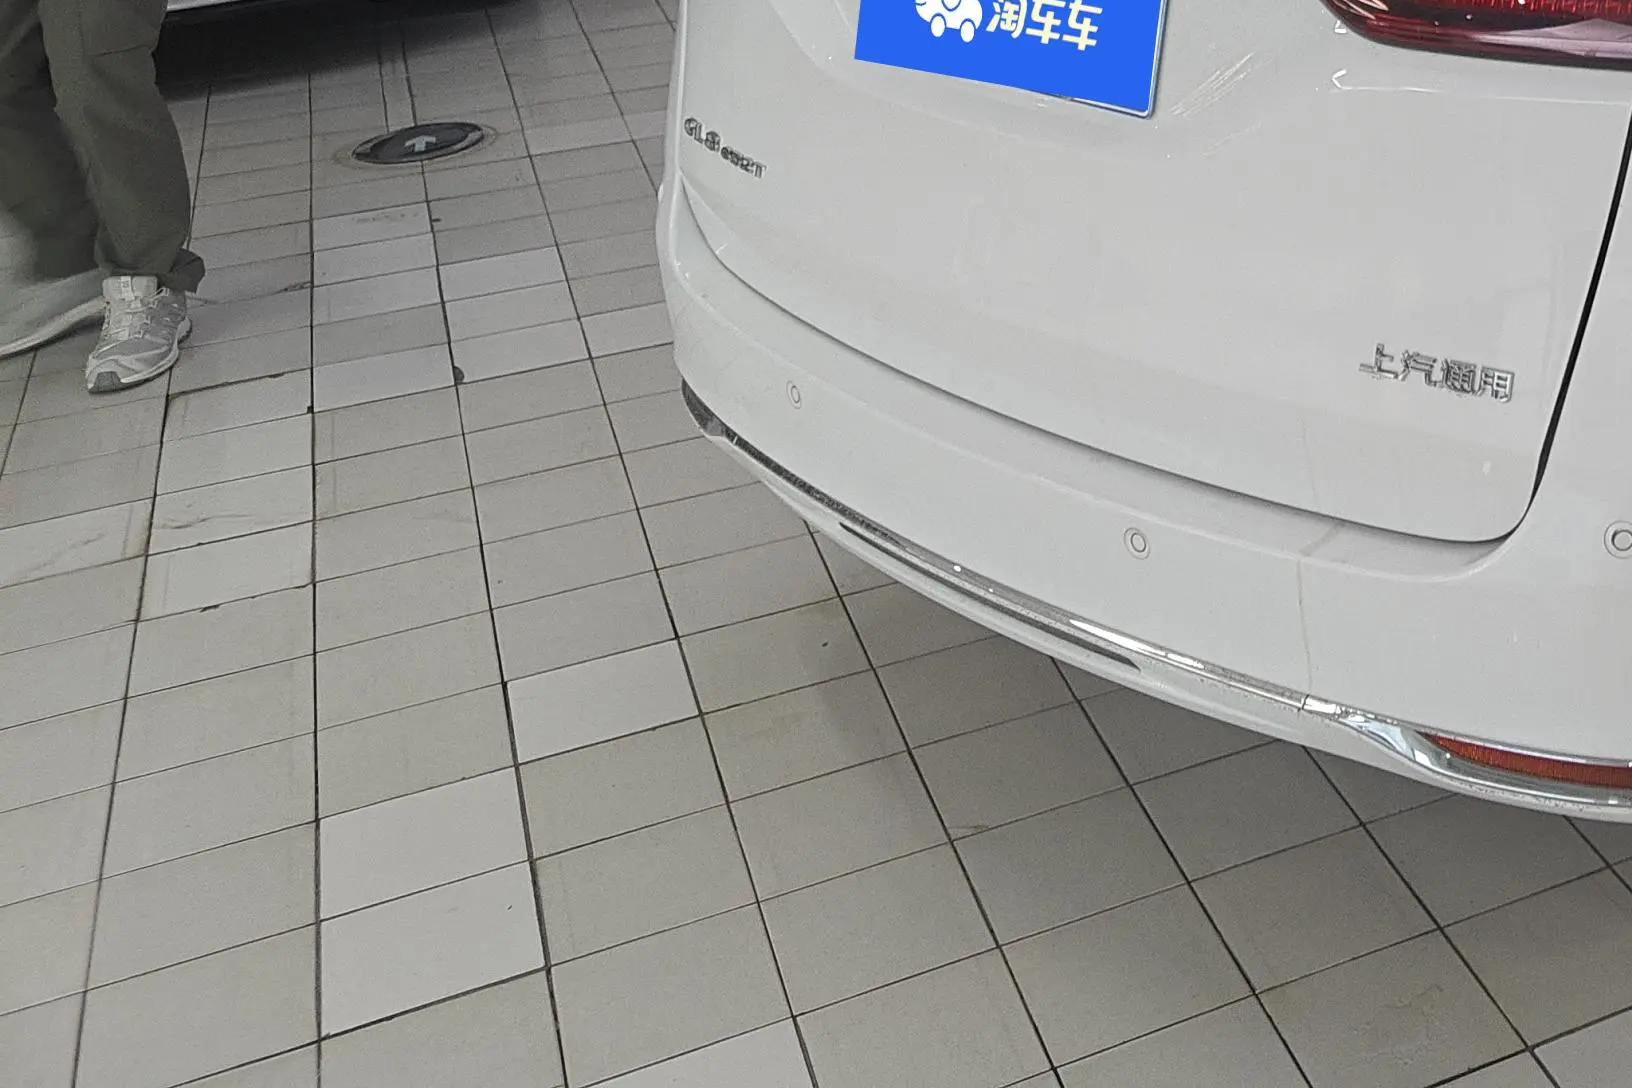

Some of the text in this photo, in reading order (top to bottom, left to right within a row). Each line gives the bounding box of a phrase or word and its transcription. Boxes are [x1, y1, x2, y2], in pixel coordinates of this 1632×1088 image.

[684, 117, 721, 153] GL8
[1359, 343, 1515, 403] 上汽通用
